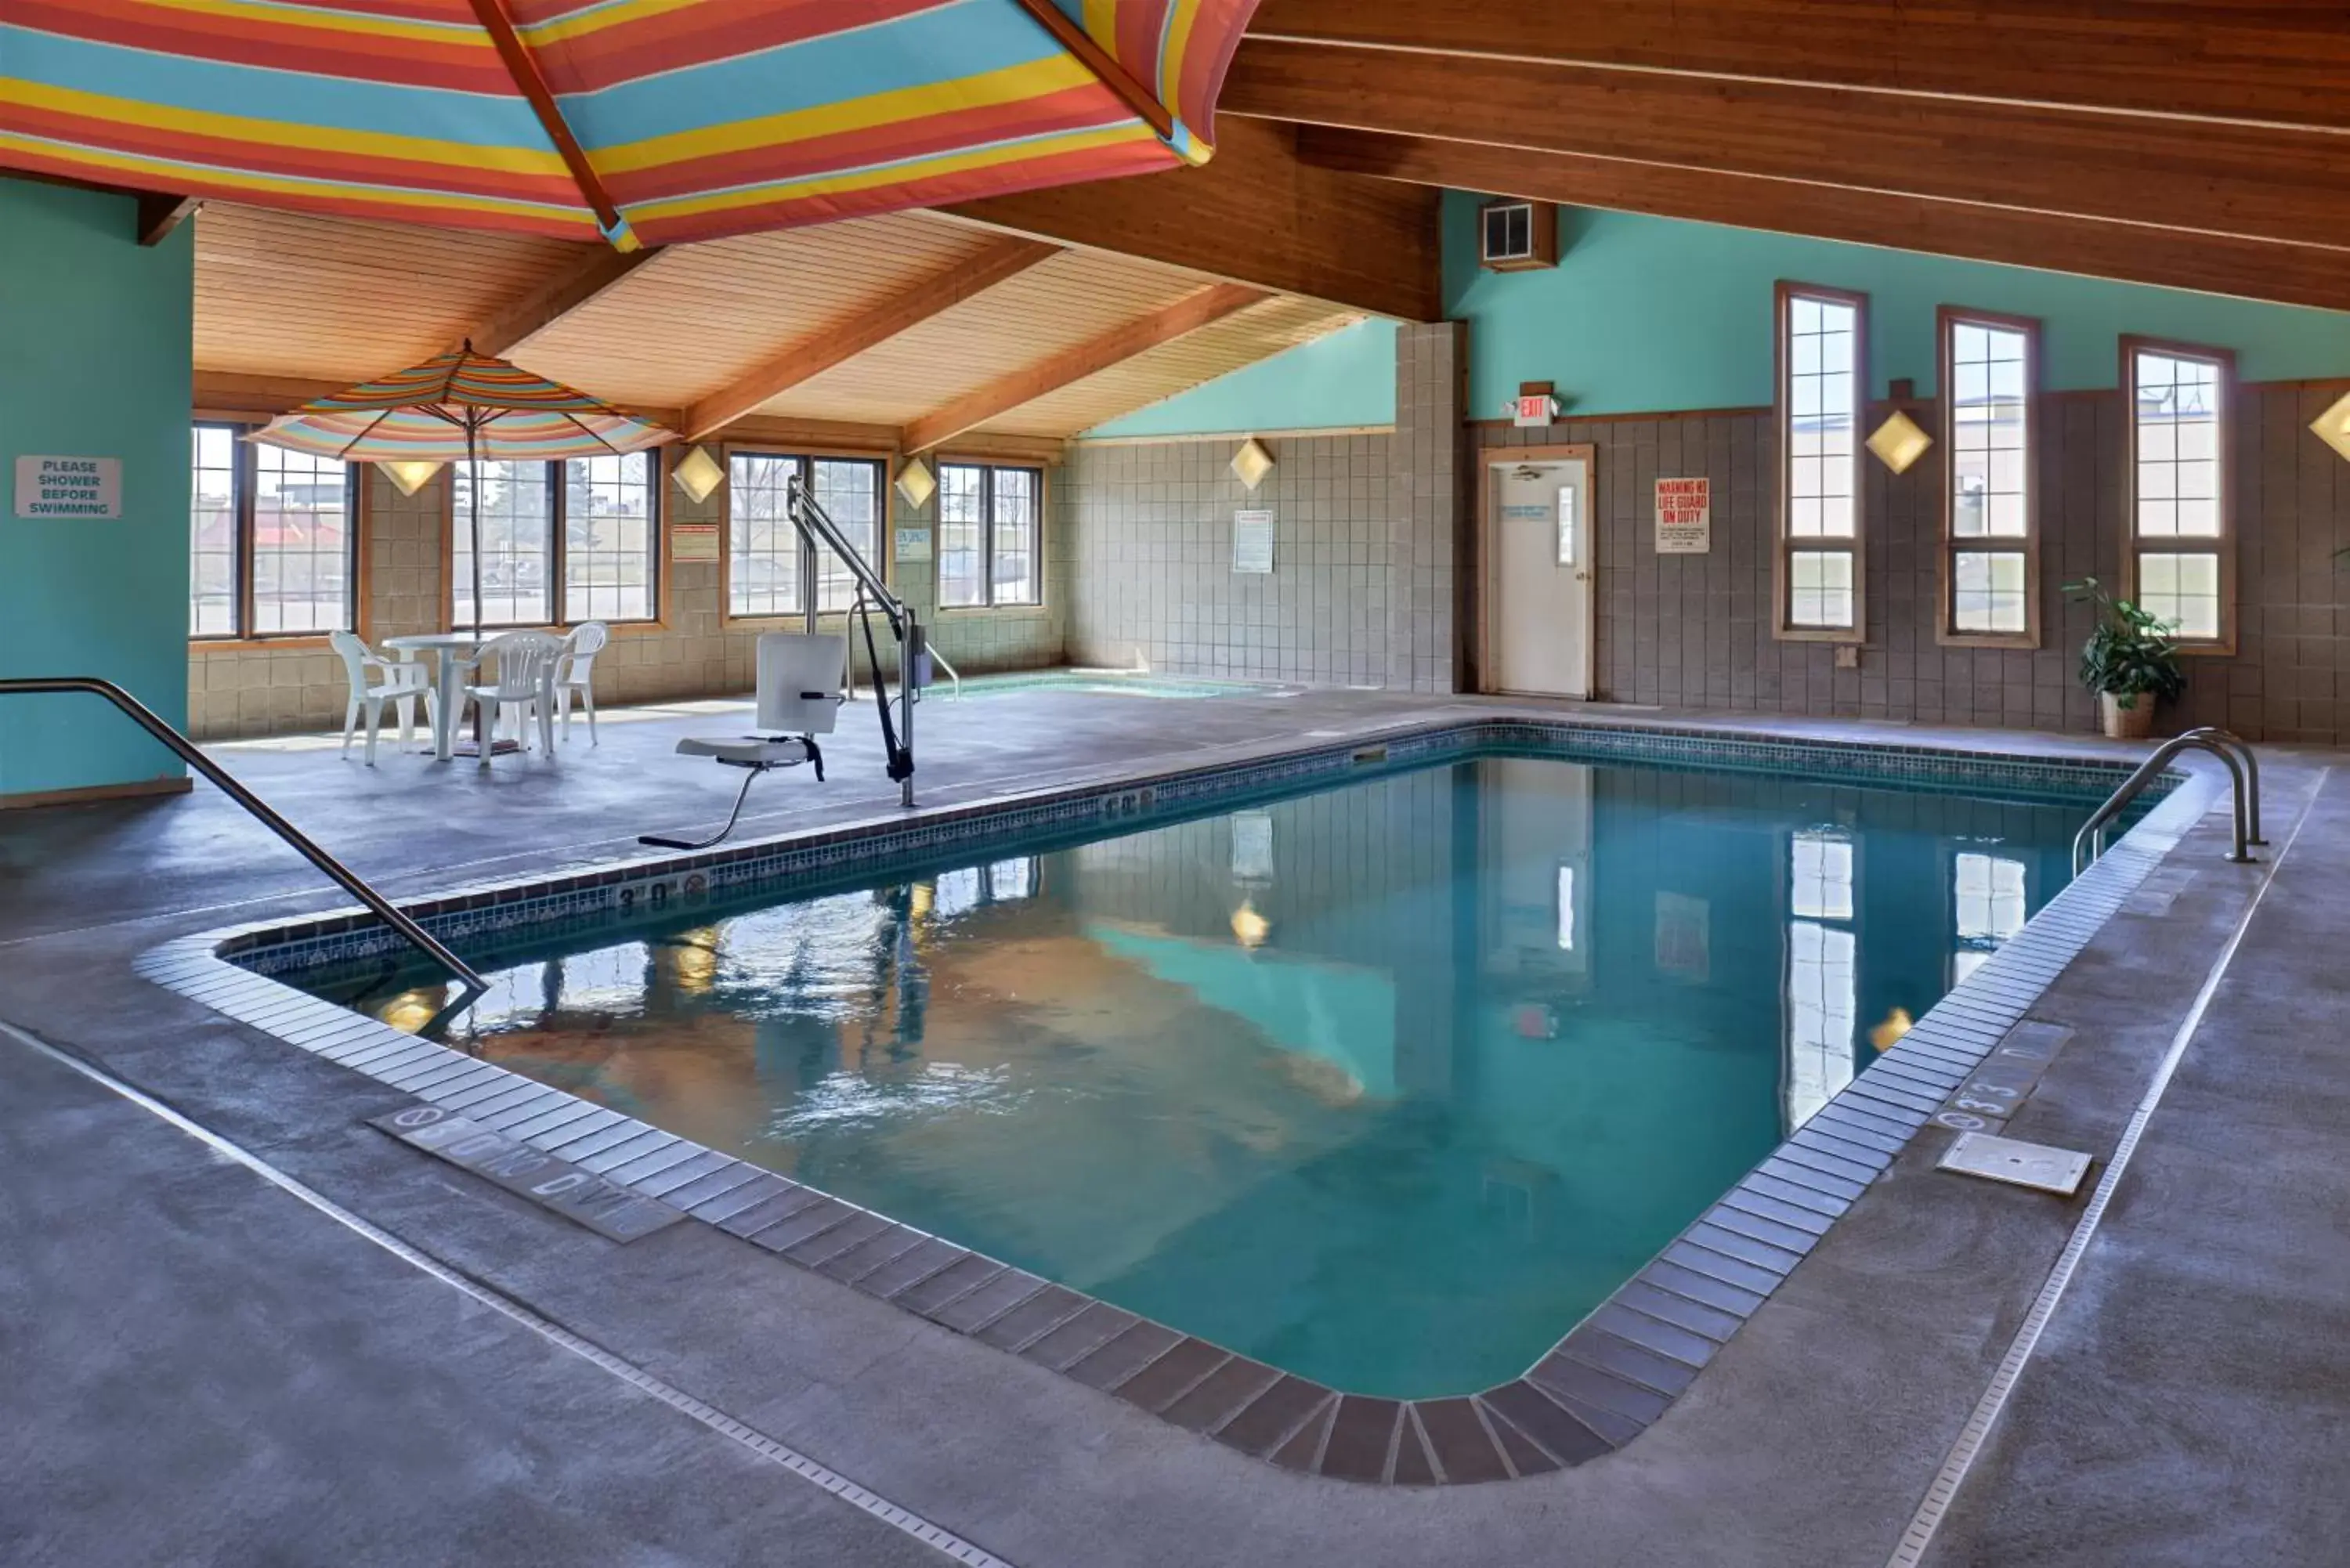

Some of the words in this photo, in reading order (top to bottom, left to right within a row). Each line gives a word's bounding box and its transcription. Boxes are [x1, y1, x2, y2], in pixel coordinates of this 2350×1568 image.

[1522, 399, 1542, 417] EXIT
[42, 461, 97, 472] PLEASE
[38, 474, 101, 486] SHOWER
[1658, 481, 1694, 494] WARNING
[41, 489, 98, 500] BEFORE
[1658, 495, 1674, 509] LIFE
[1676, 494, 1707, 508] GUARD
[29, 502, 109, 515] SWIMMING
[1663, 510, 1676, 523] ON
[1677, 509, 1701, 523] DUTY
